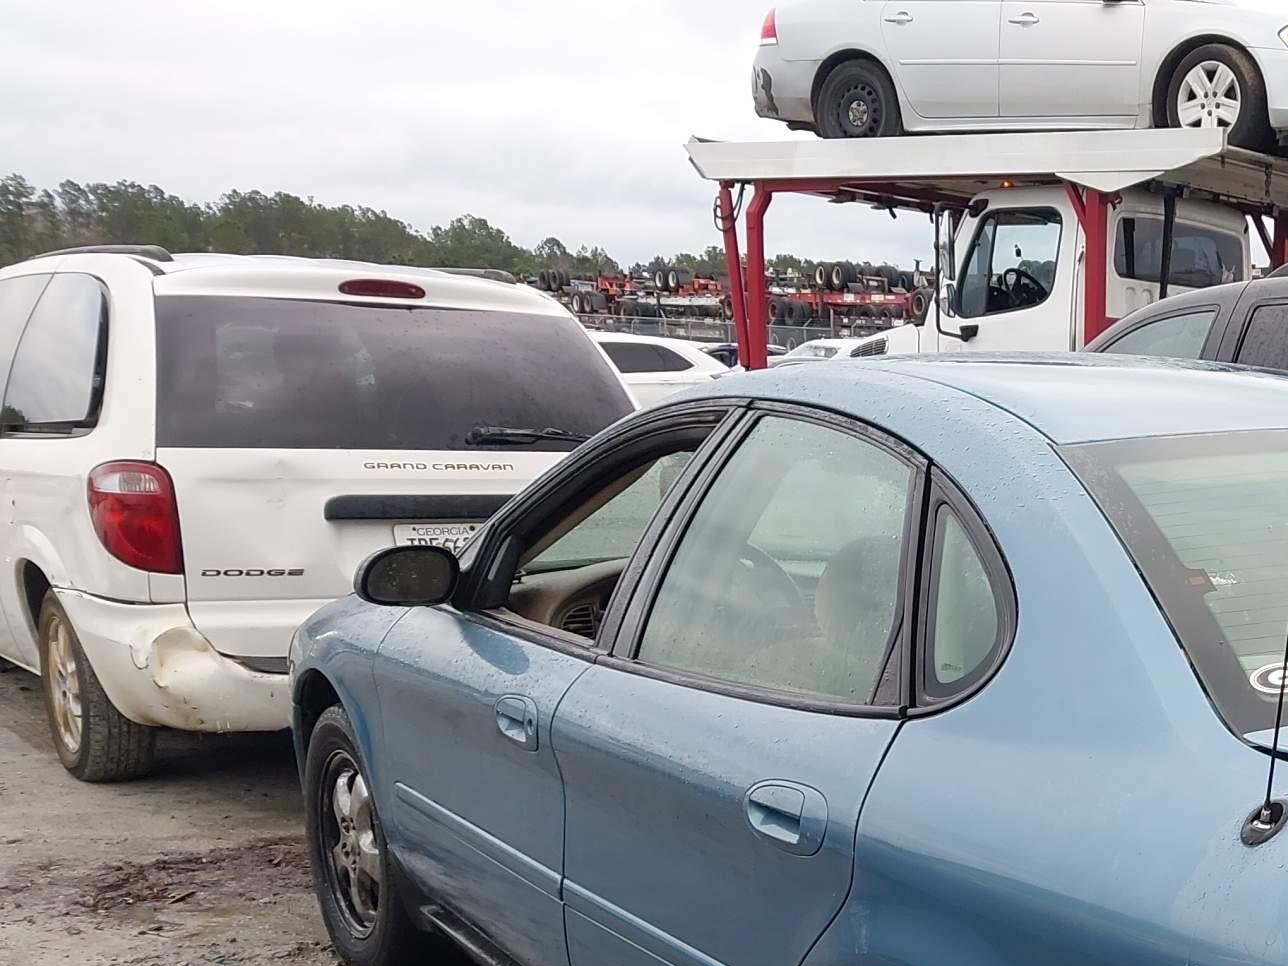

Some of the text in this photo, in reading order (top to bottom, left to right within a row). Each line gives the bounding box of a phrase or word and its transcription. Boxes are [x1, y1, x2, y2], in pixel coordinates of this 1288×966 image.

[363, 462, 514, 471] GRAND CARAVAN
[416, 527, 469, 536] GEORGIA
[201, 568, 305, 577] DODGE
